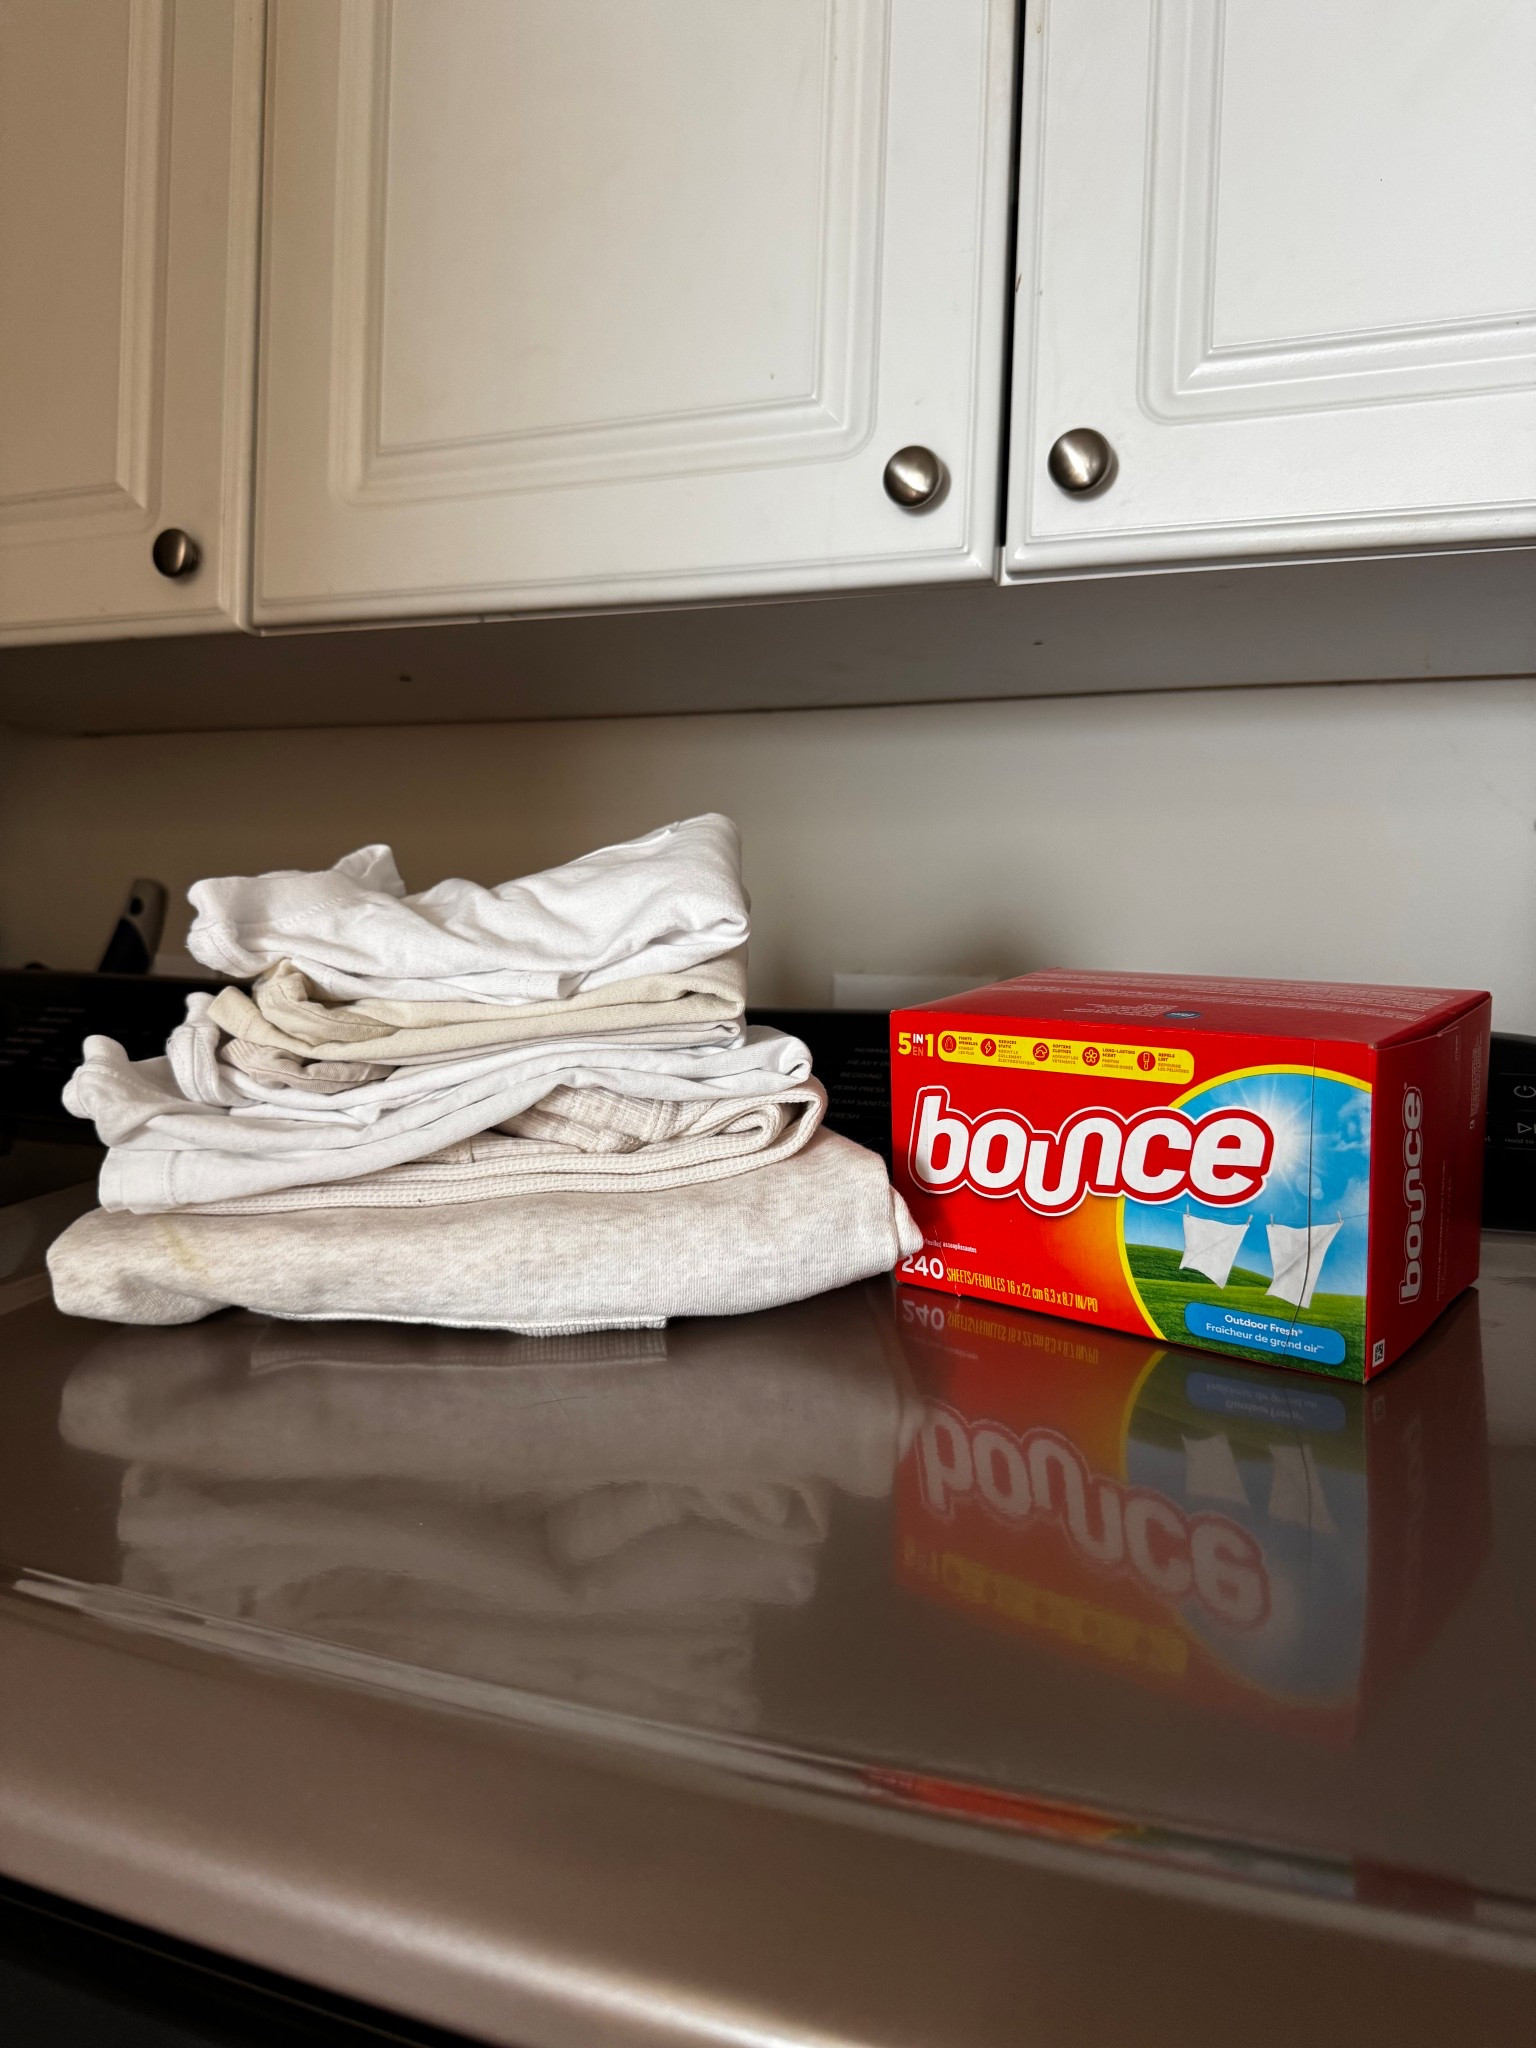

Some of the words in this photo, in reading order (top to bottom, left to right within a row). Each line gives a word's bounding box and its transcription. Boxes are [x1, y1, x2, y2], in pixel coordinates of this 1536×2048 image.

[898, 1032, 912, 1055] 5
[912, 1033, 923, 1044] IN
[925, 1033, 934, 1057] 1
[912, 1047, 924, 1057] EN
[920, 1094, 1267, 1204] bounce
[1401, 1091, 1424, 1299] bounce
[901, 1254, 944, 1280] 240
[946, 1268, 1005, 1292] SHEETS/FEUILLES
[1007, 1280, 1016, 1294] 16
[1022, 1283, 1031, 1298] 22
[1032, 1288, 1044, 1300] cm
[1044, 1287, 1056, 1303] 6.3
[1062, 1291, 1074, 1307] 8.7
[1075, 1295, 1098, 1313] IN/PO
[1224, 1314, 1267, 1331] Outdoor
[1206, 1323, 1253, 1340] Fraîcheur
[1254, 1332, 1268, 1343] de
[1270, 1336, 1302, 1350] grand
